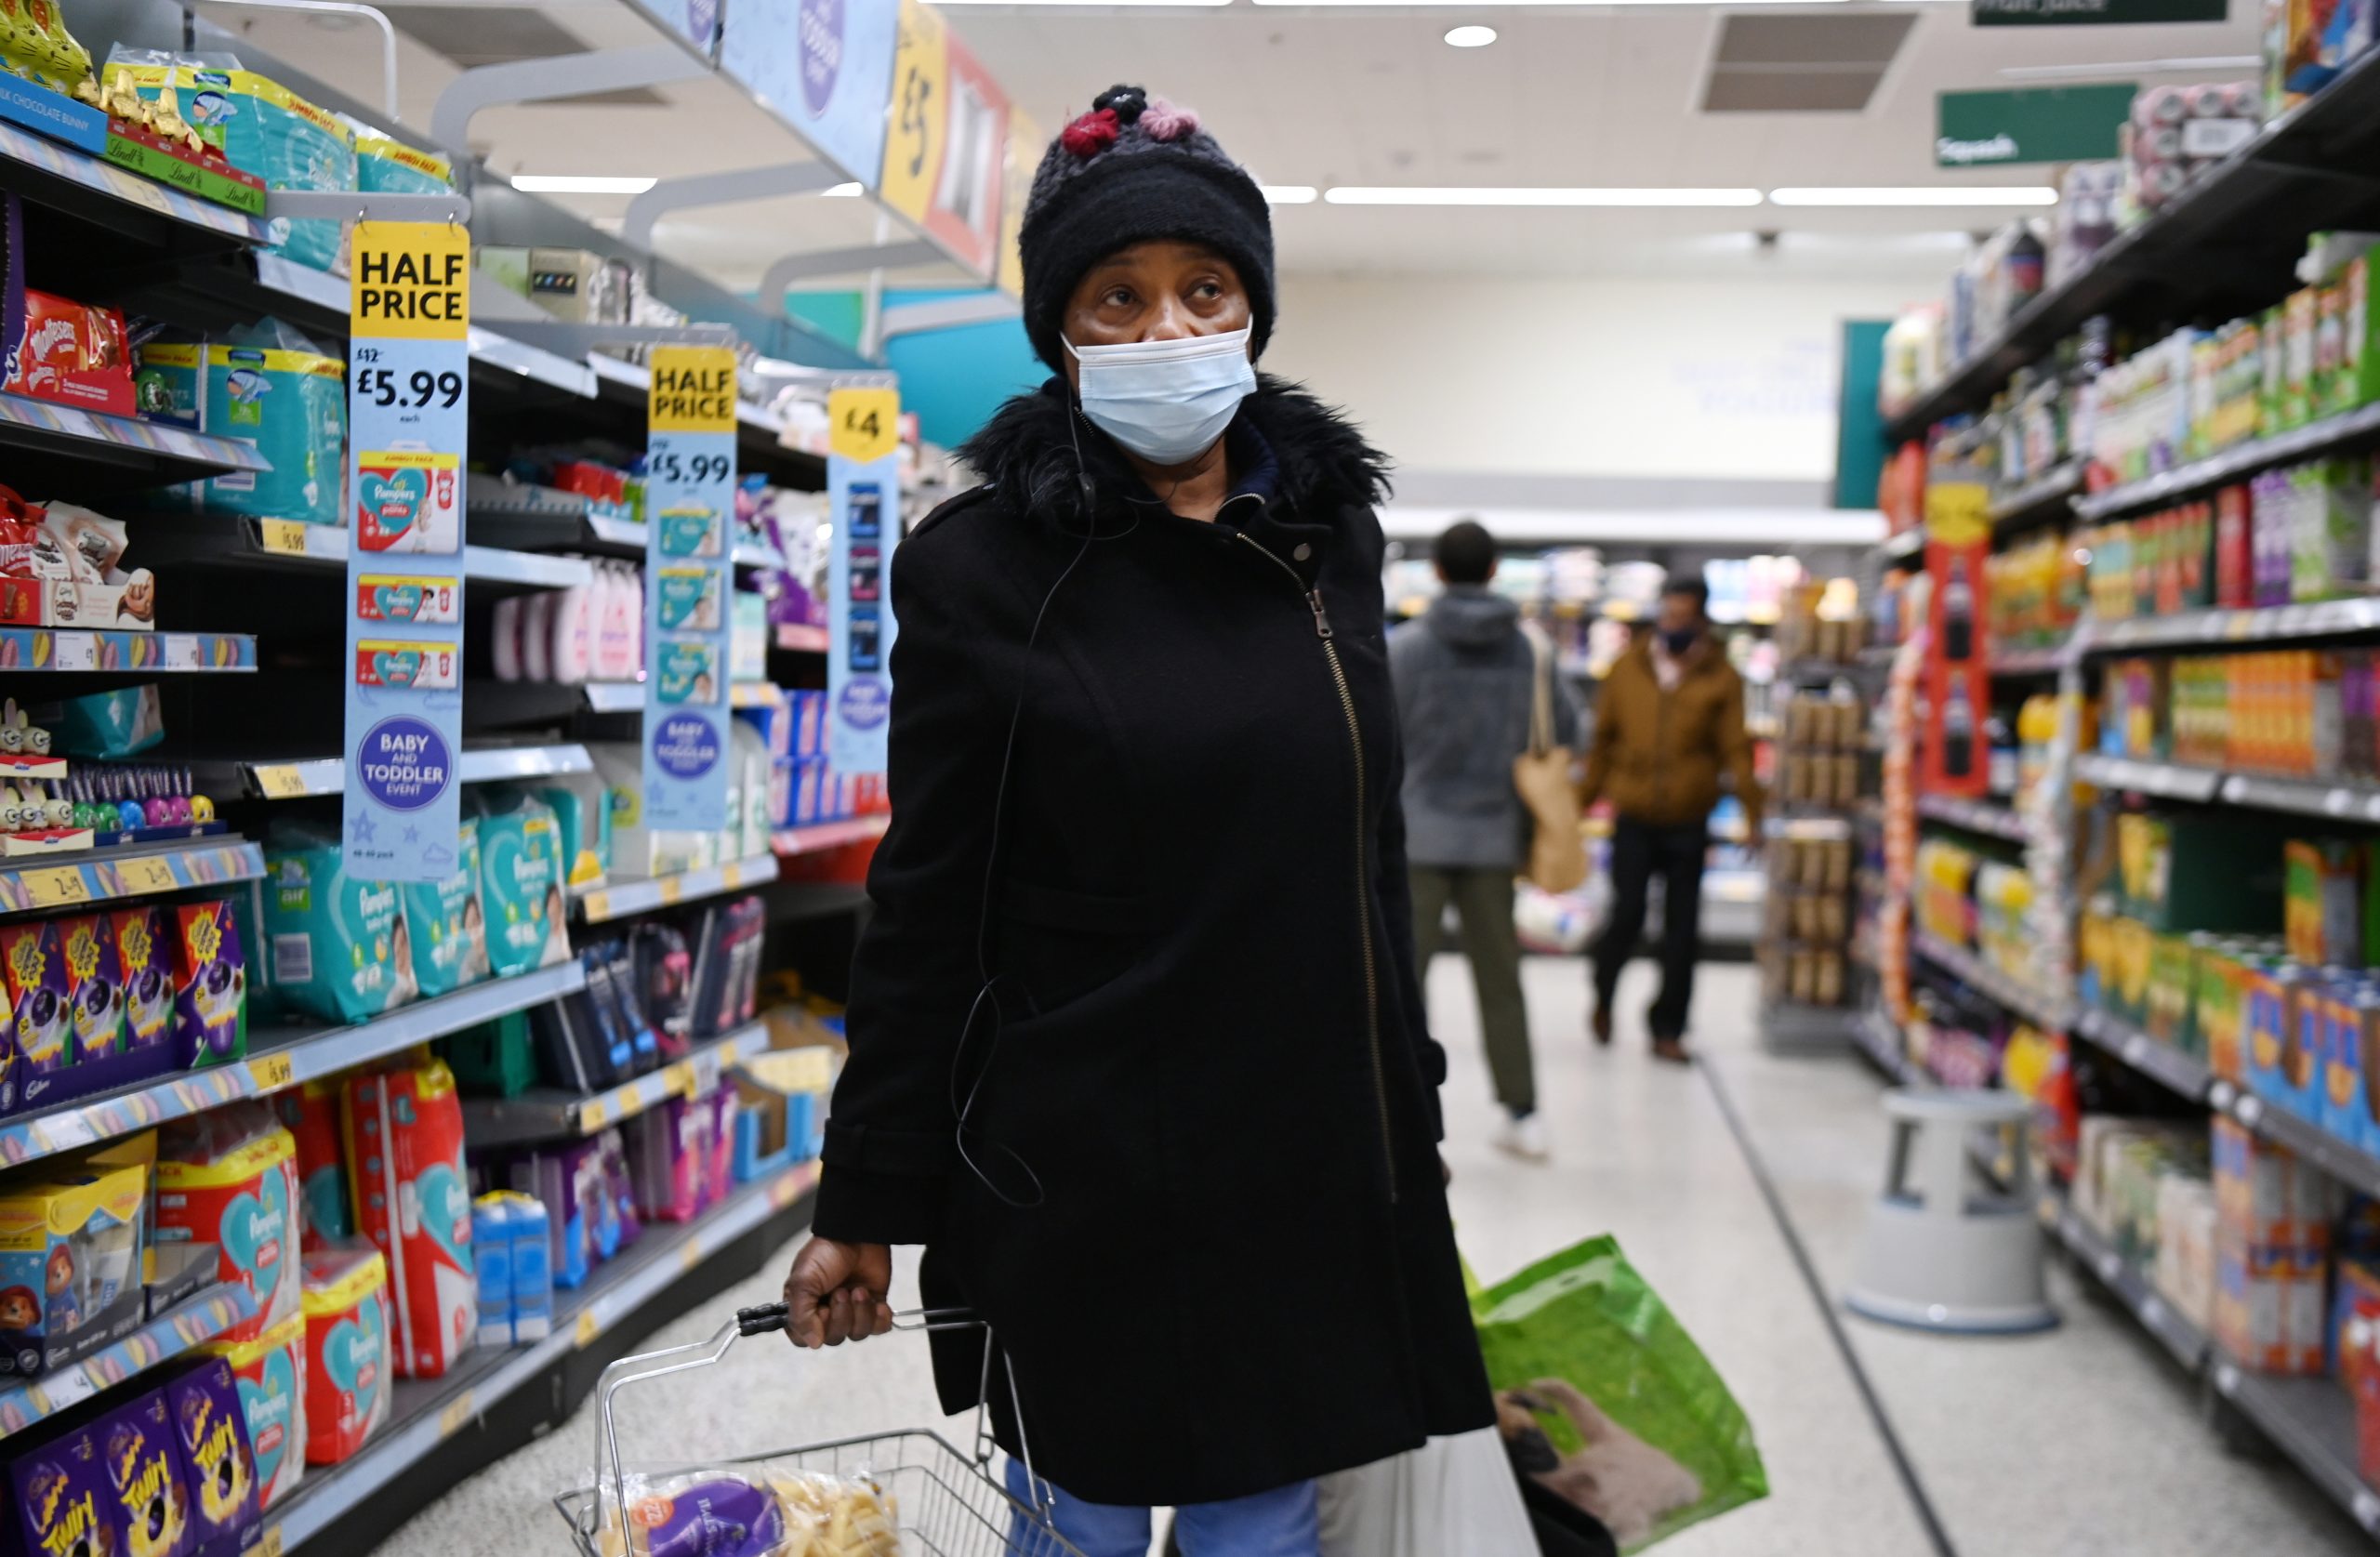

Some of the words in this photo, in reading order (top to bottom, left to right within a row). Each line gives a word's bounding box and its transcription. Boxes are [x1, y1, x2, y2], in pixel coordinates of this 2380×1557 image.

[107, 139, 138, 163] Lindt
[167, 162, 197, 187] Lindt
[224, 184, 251, 206] Lindt
[361, 252, 463, 285] HALF
[361, 290, 462, 321] PRICE
[357, 369, 462, 409] £5.99
[655, 368, 730, 392] HALF
[654, 396, 730, 418] PRICE
[845, 407, 880, 439] £4
[652, 454, 729, 483] £5.99
[375, 483, 416, 503] Pampers
[380, 733, 429, 754] BABY
[391, 752, 417, 765] AND
[364, 764, 443, 784] TODDLER
[386, 783, 421, 796] EVENT
[193, 1413, 238, 1471] Twirl
[120, 1450, 171, 1507] Twirl
[40, 1489, 98, 1555] Twirl
